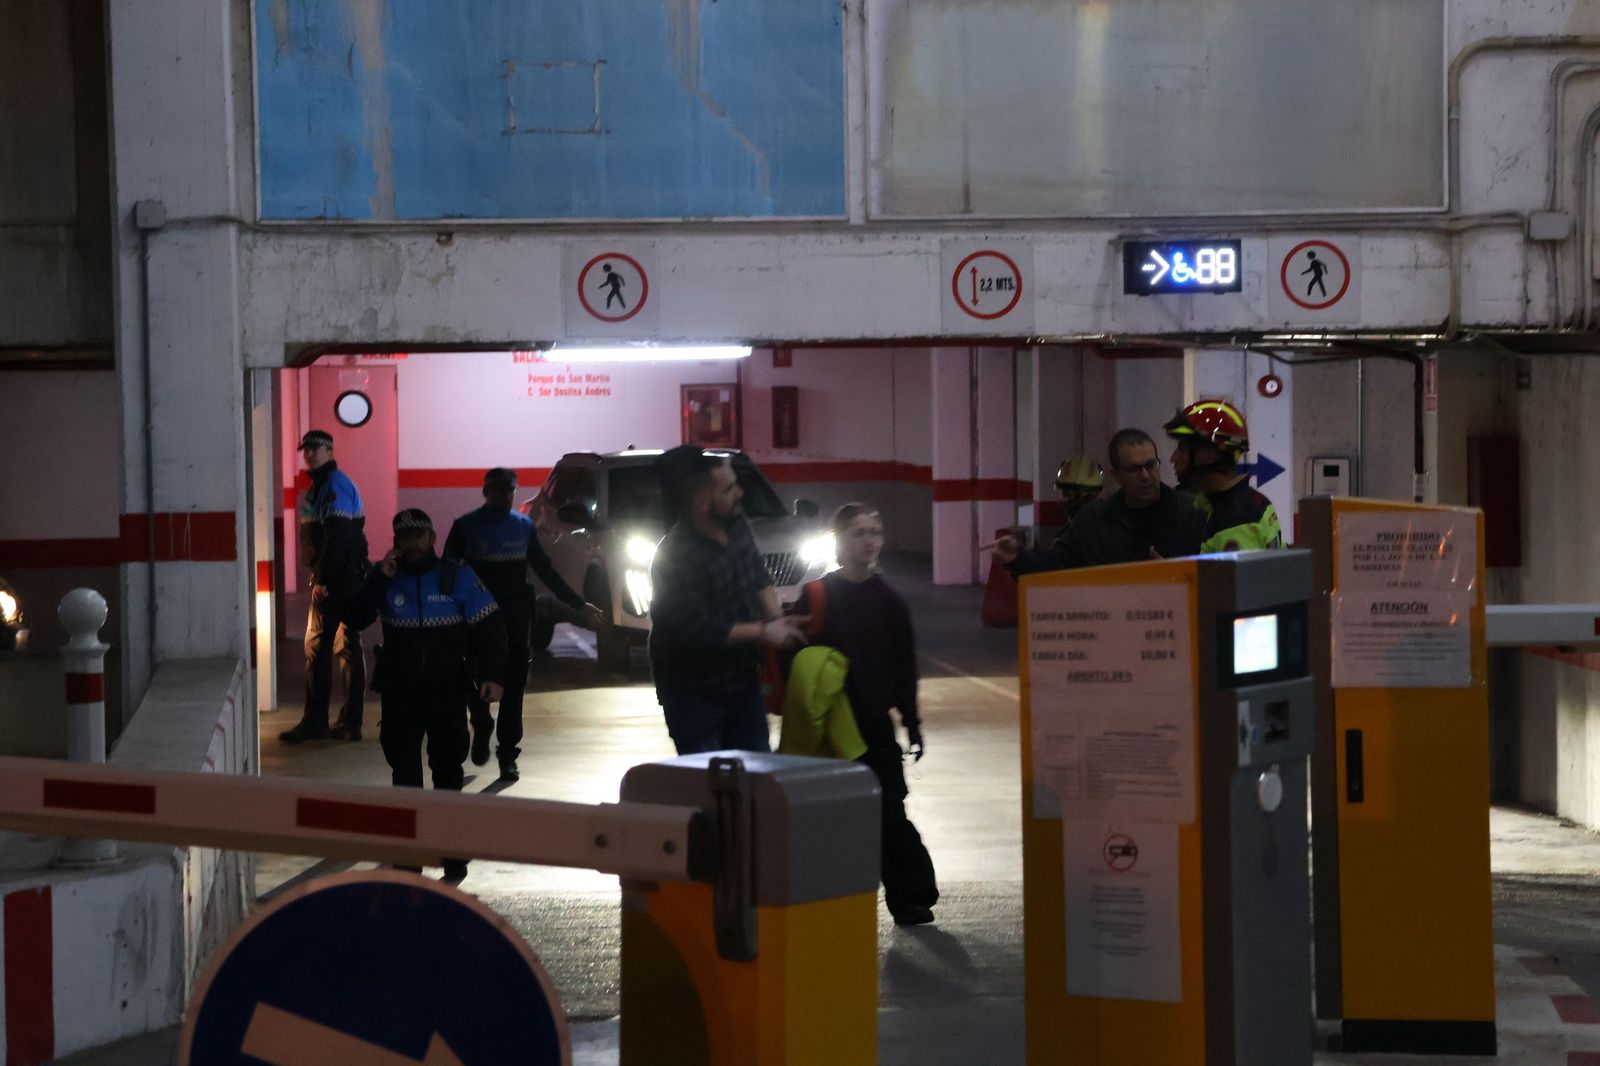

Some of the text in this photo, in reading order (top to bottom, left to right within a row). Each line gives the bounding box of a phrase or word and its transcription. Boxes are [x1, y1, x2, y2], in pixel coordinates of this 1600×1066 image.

[1196, 248, 1235, 284] 88
[980, 277, 1016, 294] 2,2 MTS.
[528, 374, 553, 384] Parque
[557, 374, 565, 383] de
[569, 374, 582, 383] San
[540, 387, 551, 396] Sor
[1377, 532, 1440, 541] PROHIBIDO
[1370, 601, 1428, 614] ATENCIÓN
[1031, 612, 1064, 621] TARIFA
[1032, 631, 1064, 640] TARIFA
[1067, 631, 1098, 641] HORA:
[1032, 651, 1065, 660] TARIFA
[1067, 670, 1109, 682] ABIERTO
